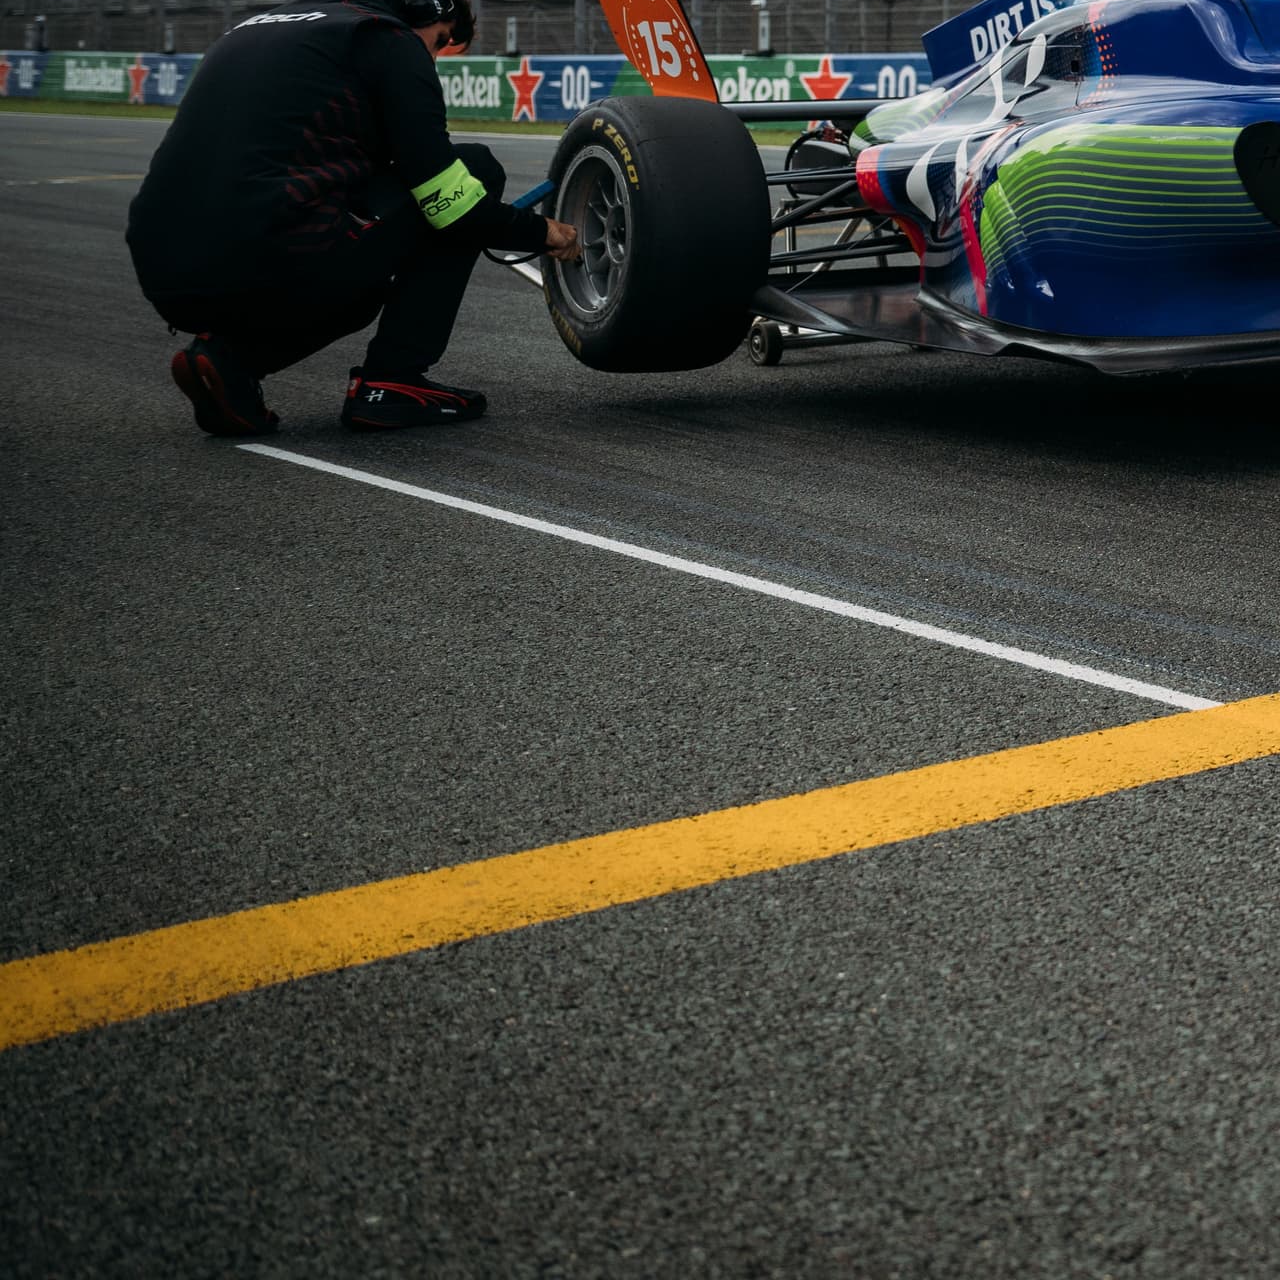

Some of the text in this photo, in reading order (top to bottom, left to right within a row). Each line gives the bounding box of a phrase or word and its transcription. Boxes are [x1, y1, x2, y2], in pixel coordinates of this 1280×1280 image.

[636, 19, 683, 79] 15
[969, 1, 1025, 62] DIRT
[591, 117, 639, 184] P ZERO
